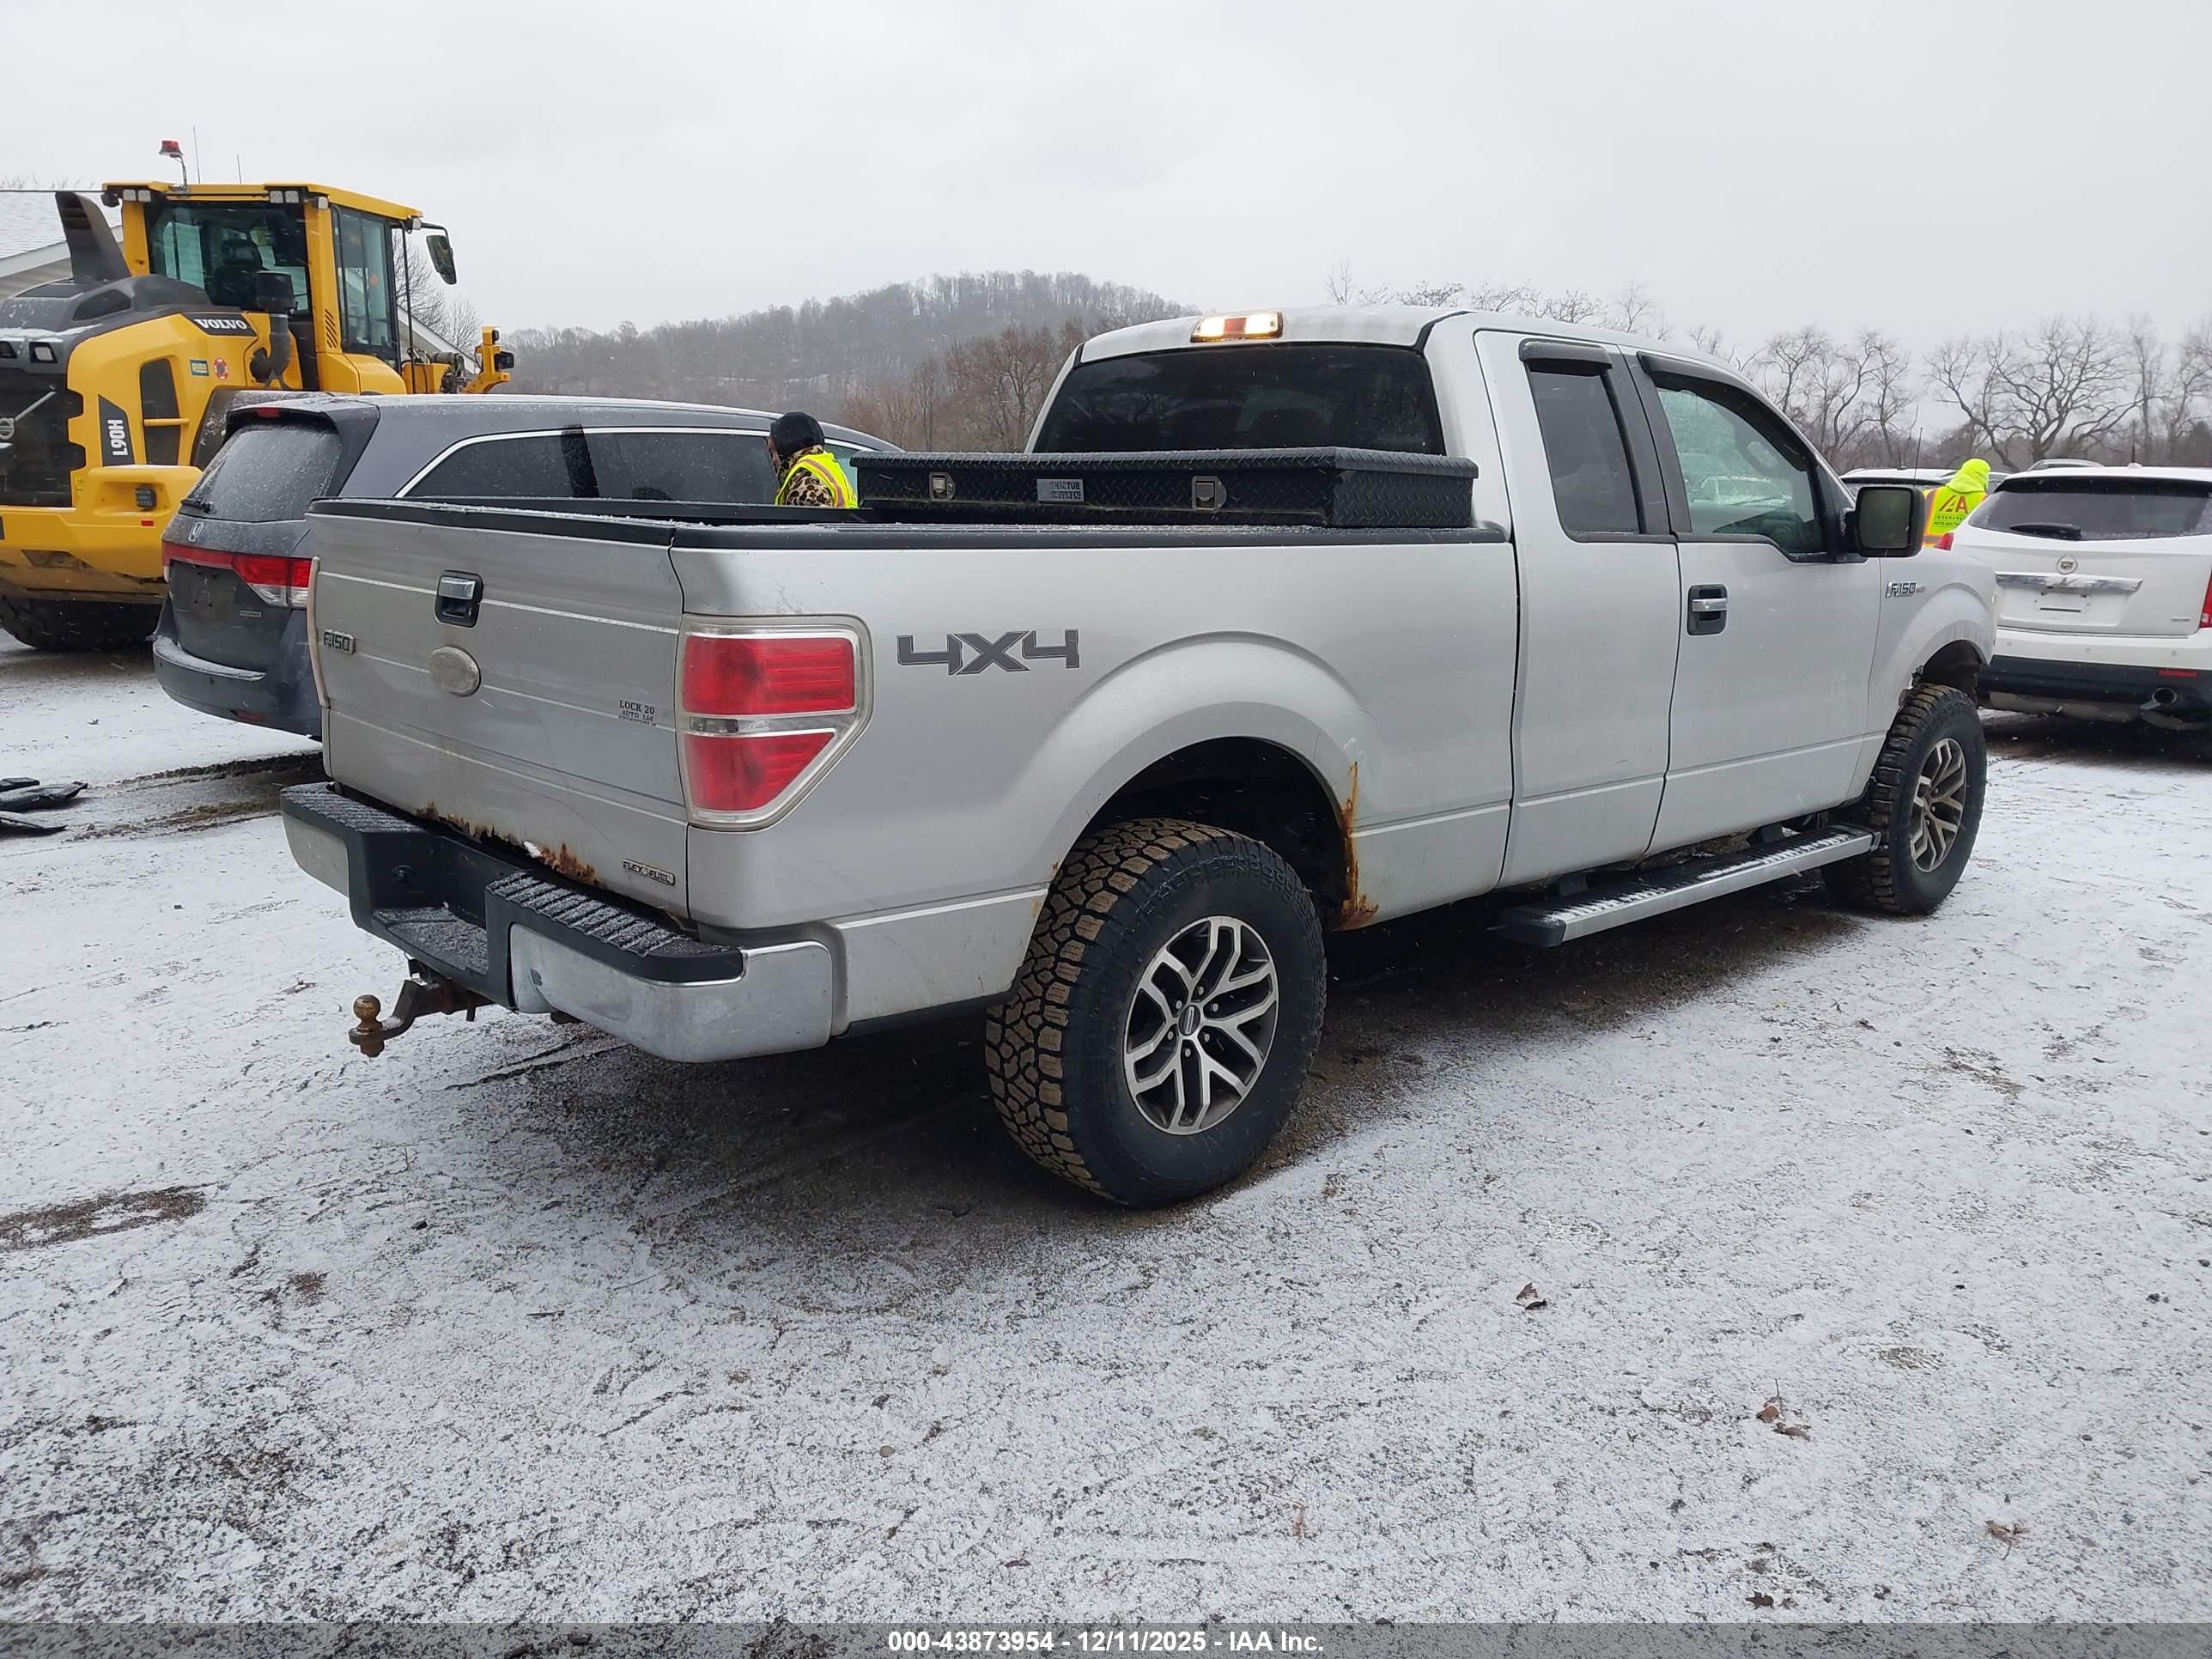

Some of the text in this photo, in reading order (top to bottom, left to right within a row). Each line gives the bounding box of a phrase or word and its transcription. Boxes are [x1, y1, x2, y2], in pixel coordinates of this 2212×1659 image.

[193, 319, 248, 330] VOLVO
[106, 419, 129, 456] L90H
[1050, 481, 1080, 490] TRACTOR
[1050, 490, 1073, 499] SUPPLY
[896, 629, 1080, 676] 4X4
[619, 700, 654, 714] LOCK 20
[623, 861, 671, 884] FLEX FUEL
